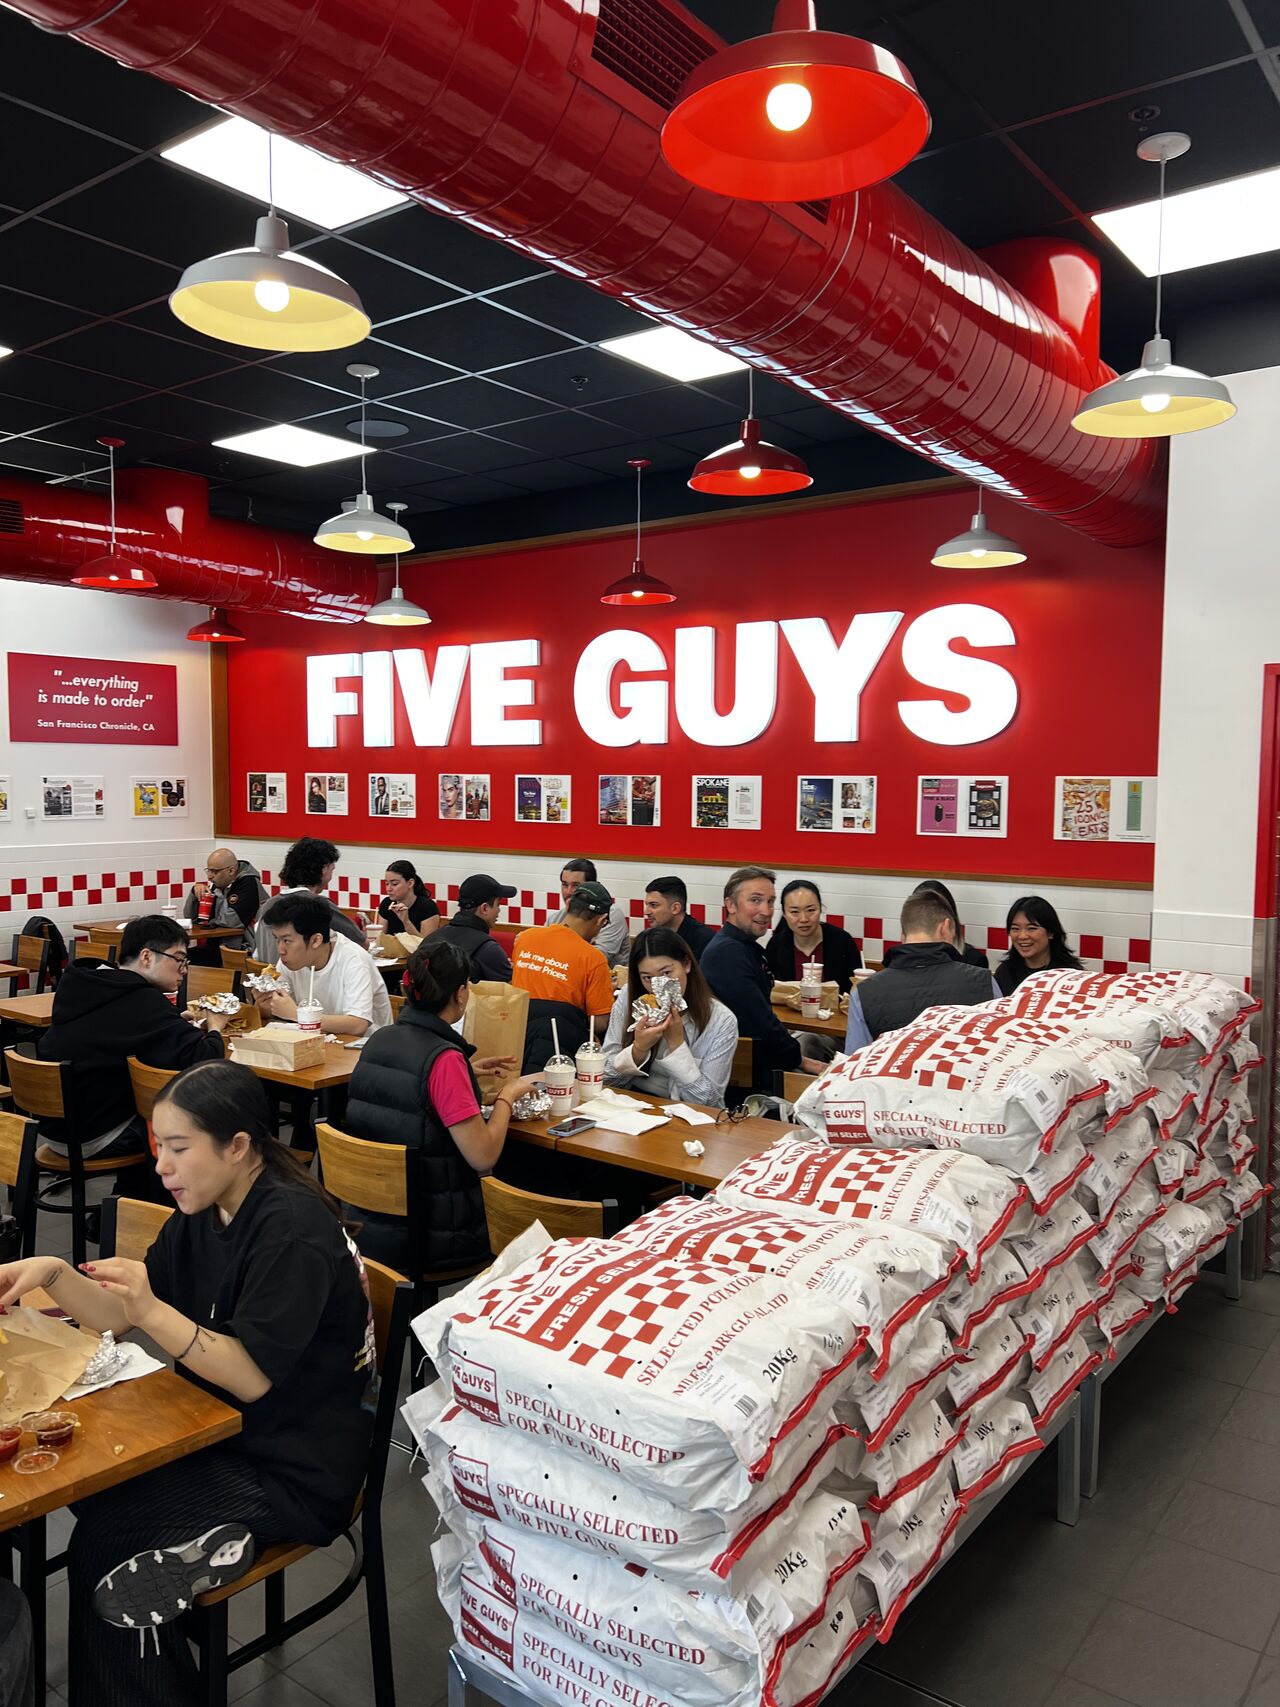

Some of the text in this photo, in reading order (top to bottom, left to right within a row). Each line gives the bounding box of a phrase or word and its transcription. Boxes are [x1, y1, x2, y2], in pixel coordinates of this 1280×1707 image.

[307, 603, 1019, 748] FIVE GUYS
[38, 689, 153, 708] is made to order"
[37, 719, 155, 732] San Francisco Chronicle, CA
[696, 778, 730, 787] SPOKANE
[1076, 801, 1093, 814] 25
[532, 954, 545, 962] me
[545, 957, 569, 970] about
[1024, 991, 1043, 1019] FRESH
[860, 1047, 889, 1075] FIVE
[889, 1041, 920, 1074] FRESH
[833, 1110, 861, 1119] GUYS
[938, 1117, 1007, 1136] SELECTED
[880, 1170, 913, 1221] SELECTED
[682, 1206, 734, 1225] GUYS
[503, 1244, 624, 1329] FIVE GUYS
[540, 1285, 600, 1342] FRESH
[637, 1311, 704, 1386] SELECTED
[763, 1347, 798, 1384] 20Kg
[462, 1372, 491, 1393] GUYS
[505, 1389, 587, 1434] SPECIALLY
[508, 1412, 622, 1474] FOR FIVE GUYS
[453, 1465, 483, 1487] GUYS
[497, 1483, 679, 1545] SPECIALLY SELECTED
[503, 1502, 620, 1556] FOR FIVE GUYS
[496, 1572, 515, 1600] LECT
[480, 1604, 508, 1632] GUYS
[519, 1572, 706, 1666] SPECIALLY SELECTED
[480, 1635, 512, 1663] SELECT
[555, 1616, 589, 1645] FIVE
[593, 1639, 643, 1668] GUYS
[522, 1632, 610, 1689] SPECIALLY
[522, 1655, 591, 1706] FOR FIVE
